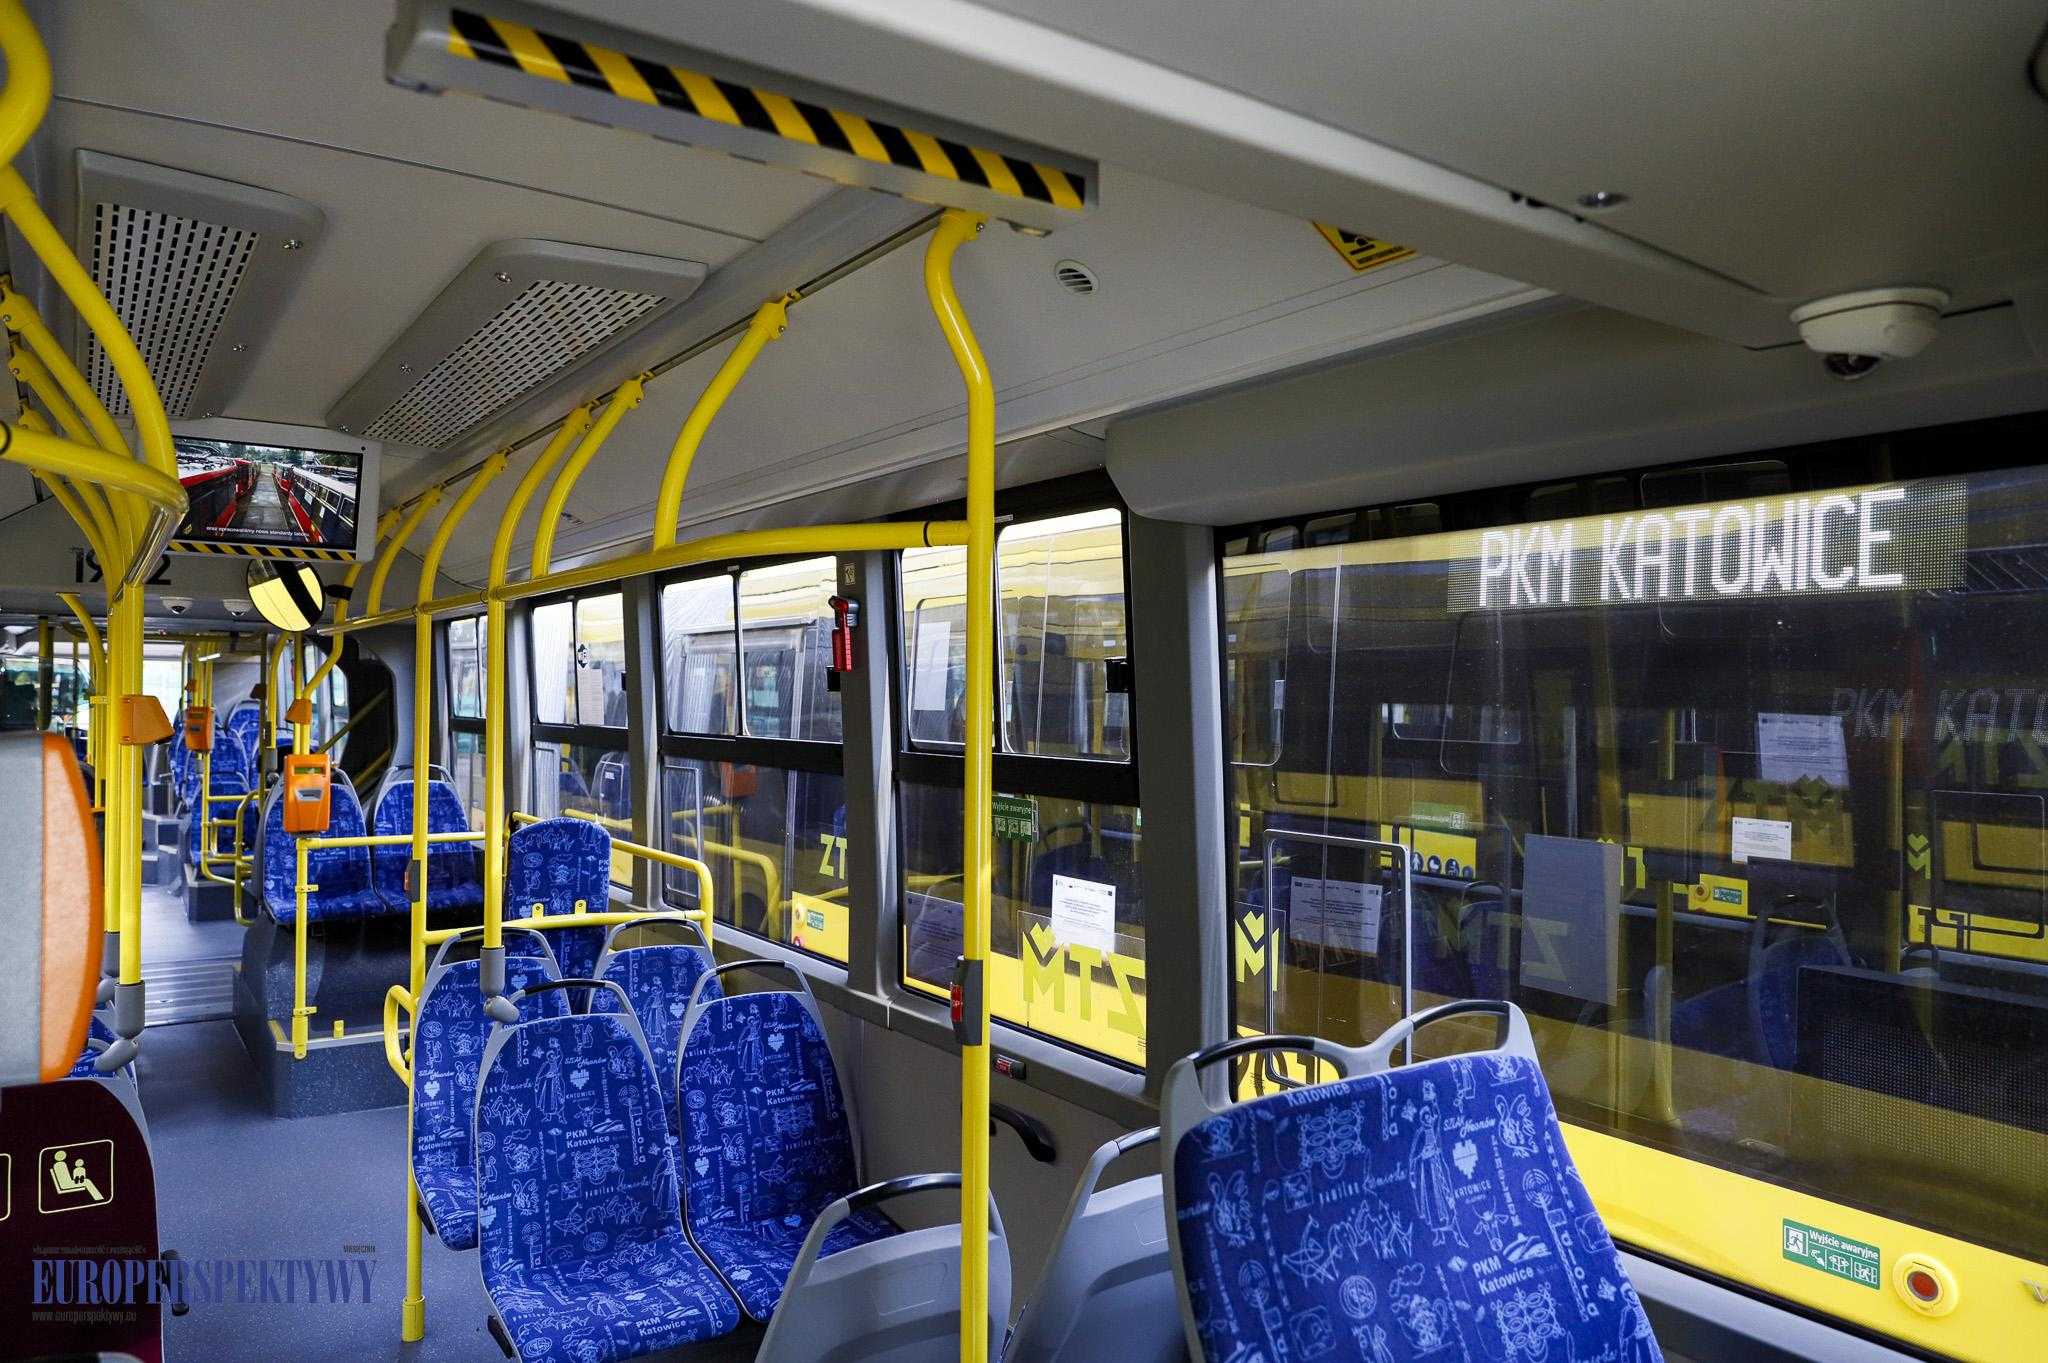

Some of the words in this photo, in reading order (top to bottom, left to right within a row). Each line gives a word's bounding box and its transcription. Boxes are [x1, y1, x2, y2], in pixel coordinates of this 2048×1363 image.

[1479, 523, 1572, 607] PKM
[1601, 488, 1905, 601] KATOWICE
[766, 1088, 785, 1097] PKM
[418, 1134, 436, 1143] PKM
[566, 1129, 588, 1140] PKM
[418, 1141, 452, 1151] Katowice
[566, 1136, 610, 1149] Katowice
[1454, 1179, 1491, 1199] KATOWICE
[1809, 1230, 1840, 1247] Wyjście
[1840, 1241, 1879, 1260] awaryjne
[1472, 1255, 1502, 1279] PKM
[1478, 1266, 1534, 1296] Katowice
[636, 1317, 661, 1328] PKM
[638, 1320, 686, 1337] Katowice
